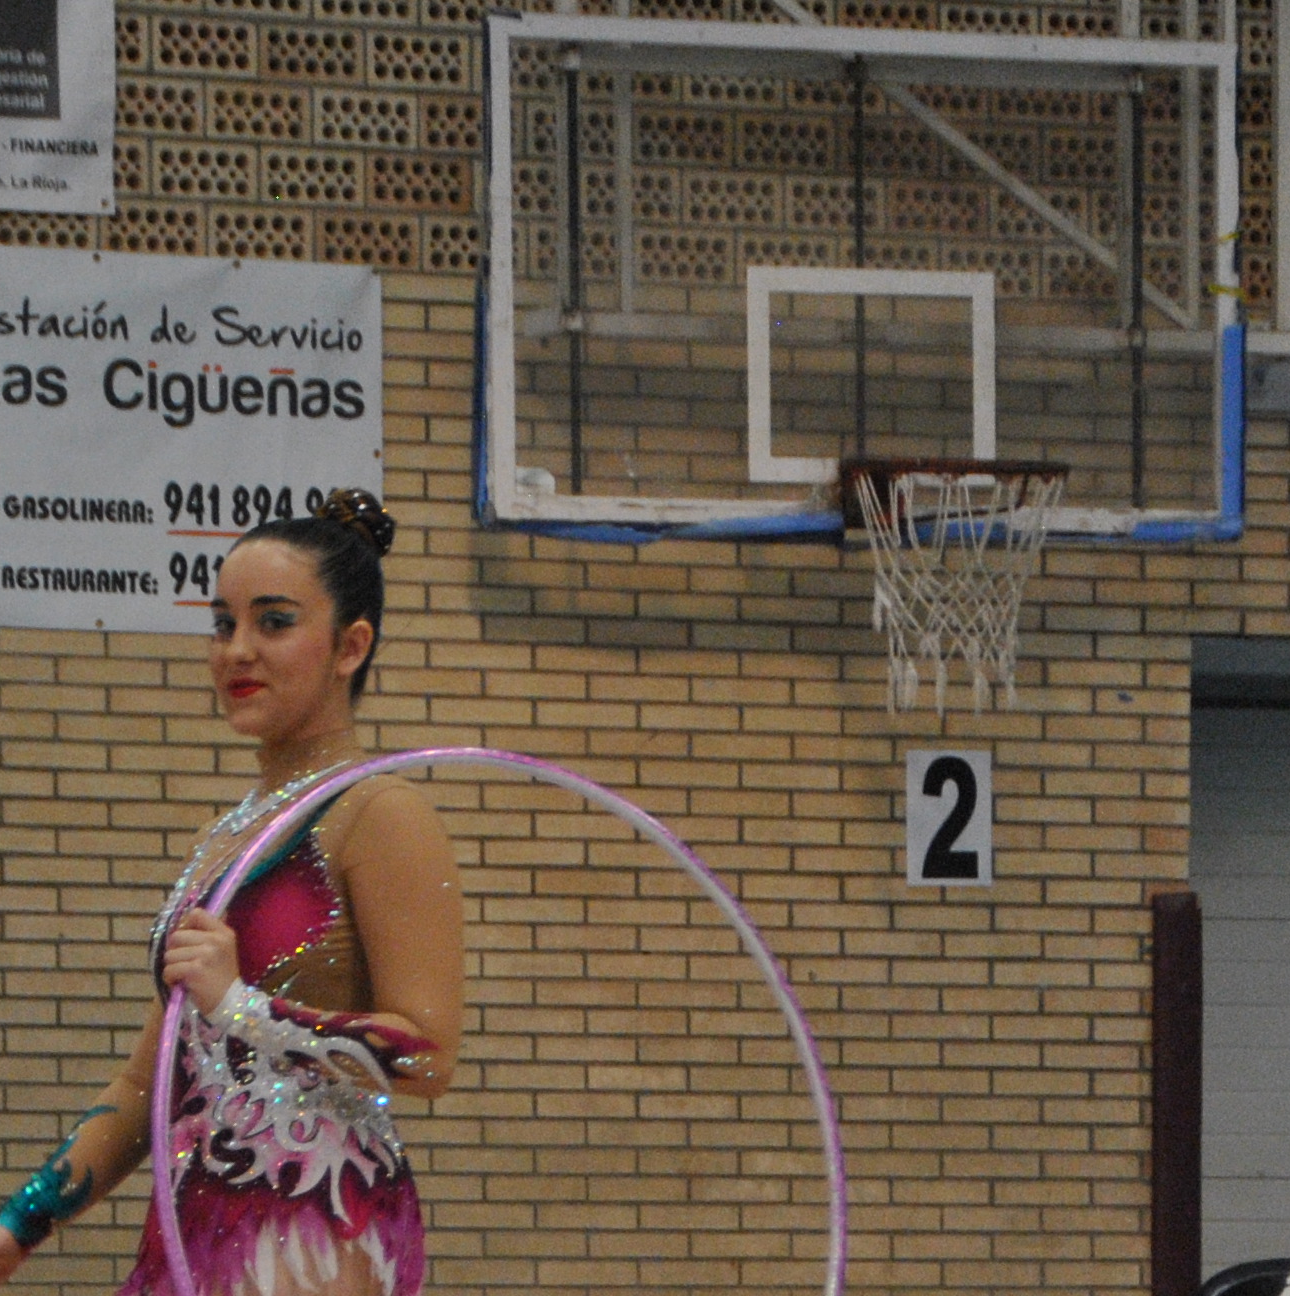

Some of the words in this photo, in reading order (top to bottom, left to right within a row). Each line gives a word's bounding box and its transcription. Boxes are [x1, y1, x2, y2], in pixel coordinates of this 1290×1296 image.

[10, 137, 99, 157] FINANCIERA
[10, 174, 28, 189] La
[149, 304, 197, 346] de
[212, 305, 364, 353] Servicio
[103, 357, 366, 429] Cigüeñas
[3, 495, 154, 524] GASOLINERA:
[163, 481, 220, 527] 941
[232, 484, 294, 528] 894
[1, 564, 158, 596] RESTAURANTE:
[921, 756, 979, 879] 2
